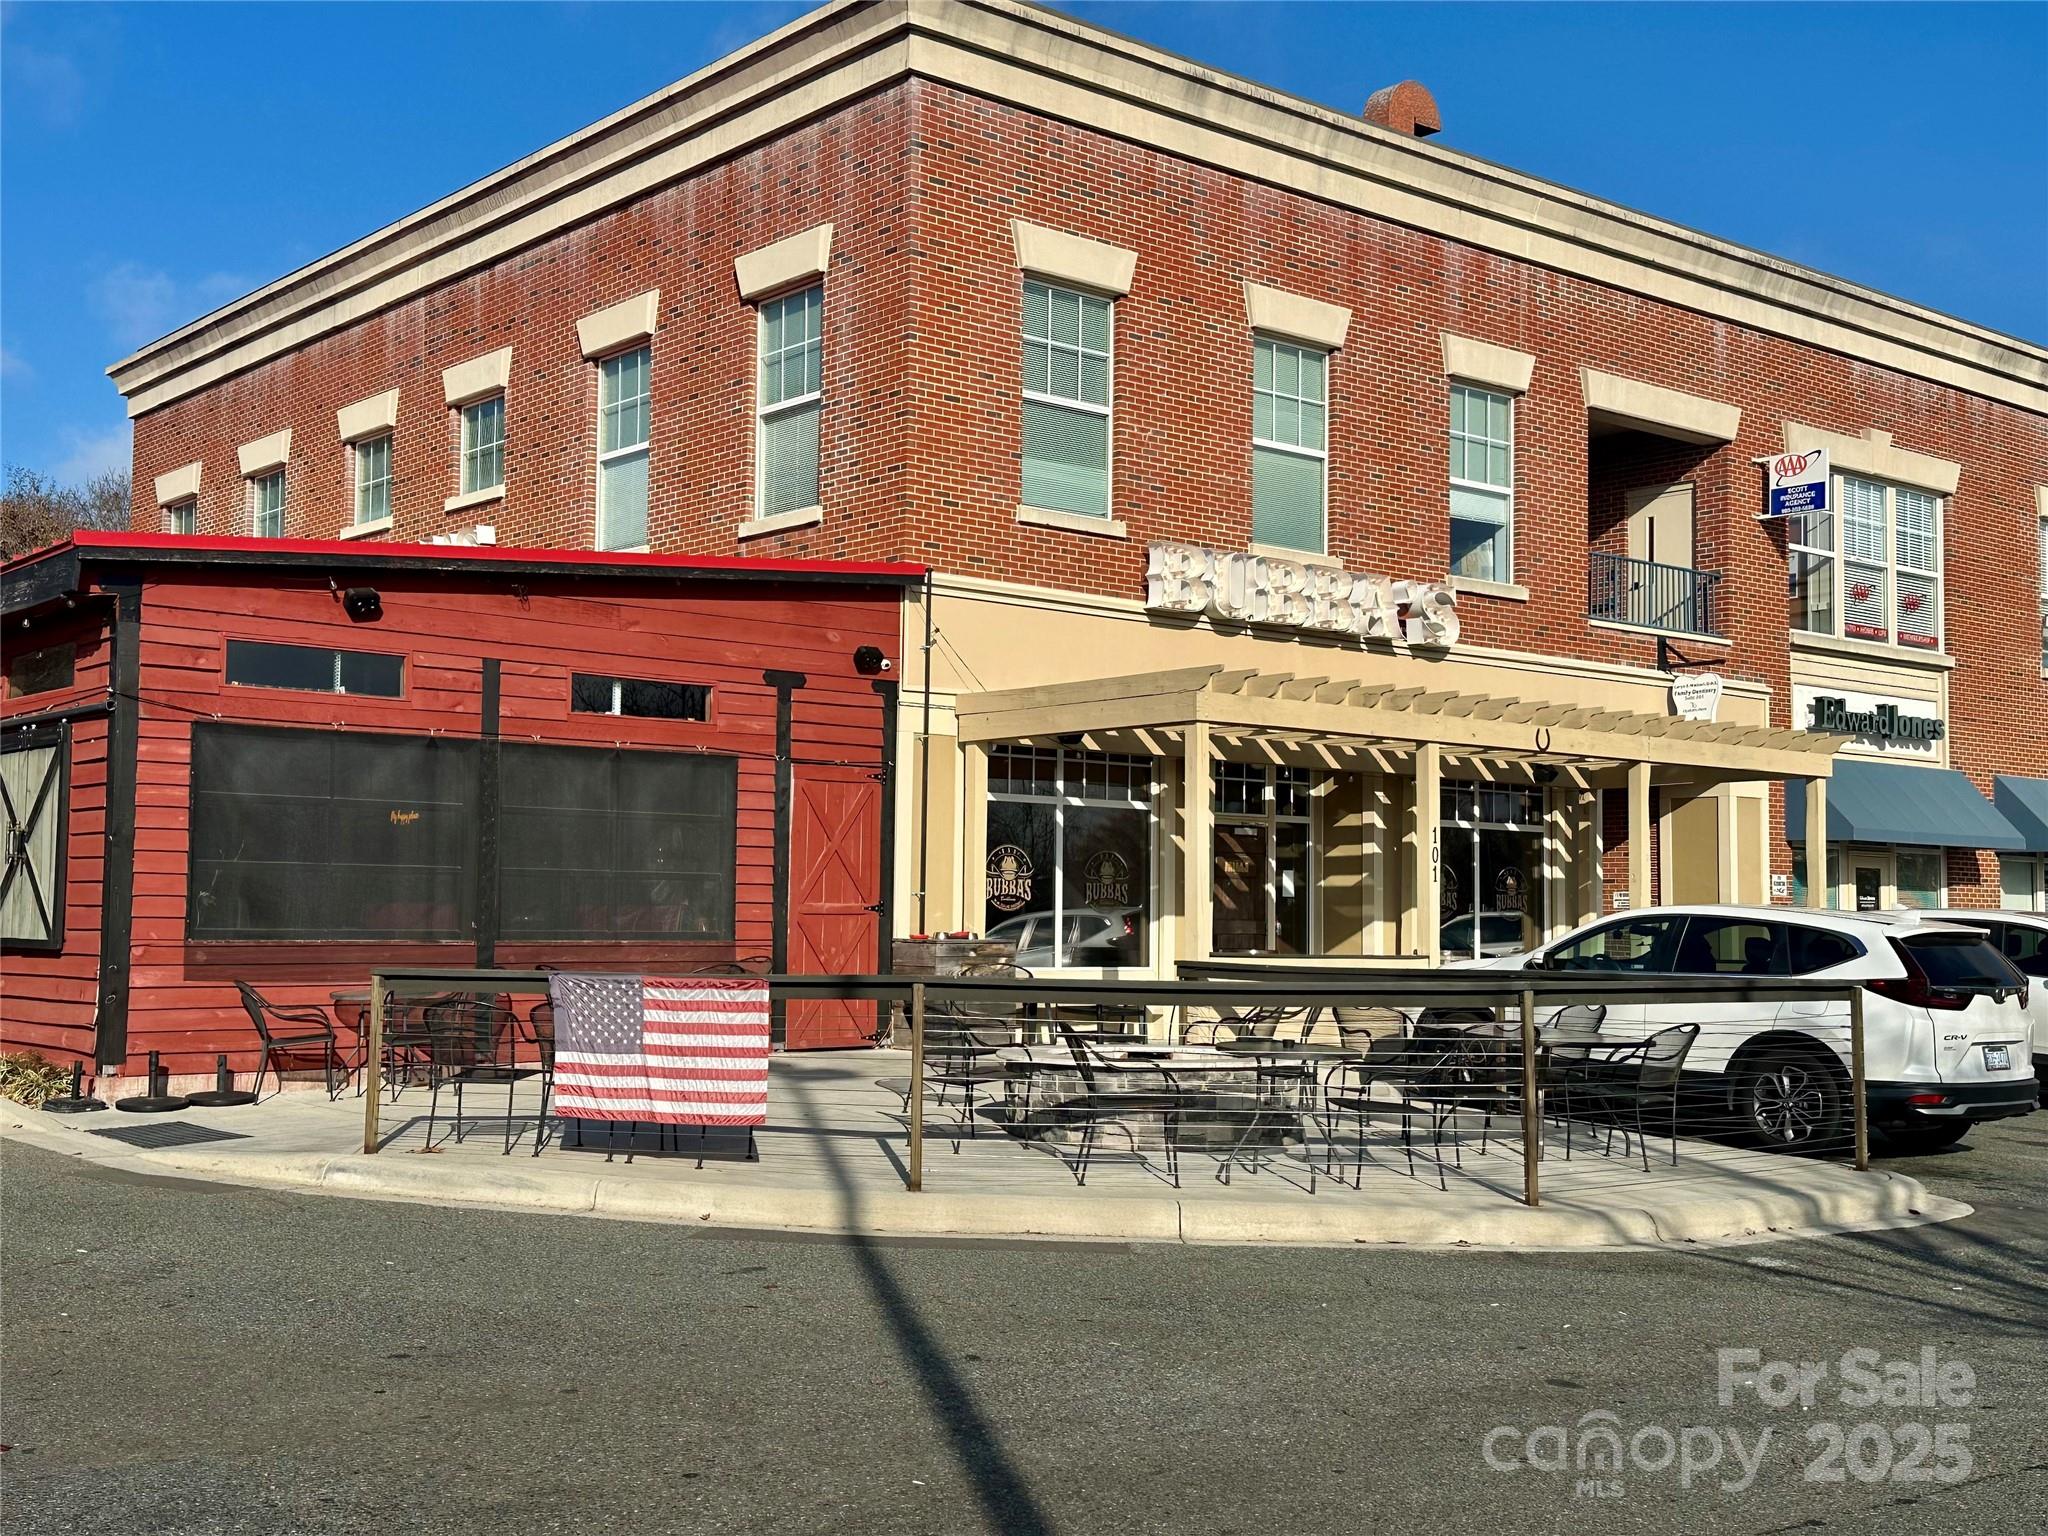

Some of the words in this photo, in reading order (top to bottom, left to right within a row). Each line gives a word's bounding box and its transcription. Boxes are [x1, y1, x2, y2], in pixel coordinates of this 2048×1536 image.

[1777, 455, 1806, 477] AAA
[1780, 490, 1816, 501] INSURANCE
[1787, 485, 1808, 494] SCOTT
[1784, 498, 1811, 507] AGENCY
[1814, 696, 1890, 736] Edward
[1890, 705, 1945, 740] Jones
[986, 877, 1031, 901] BUBBAS
[1085, 882, 1128, 904] BUBBAS
